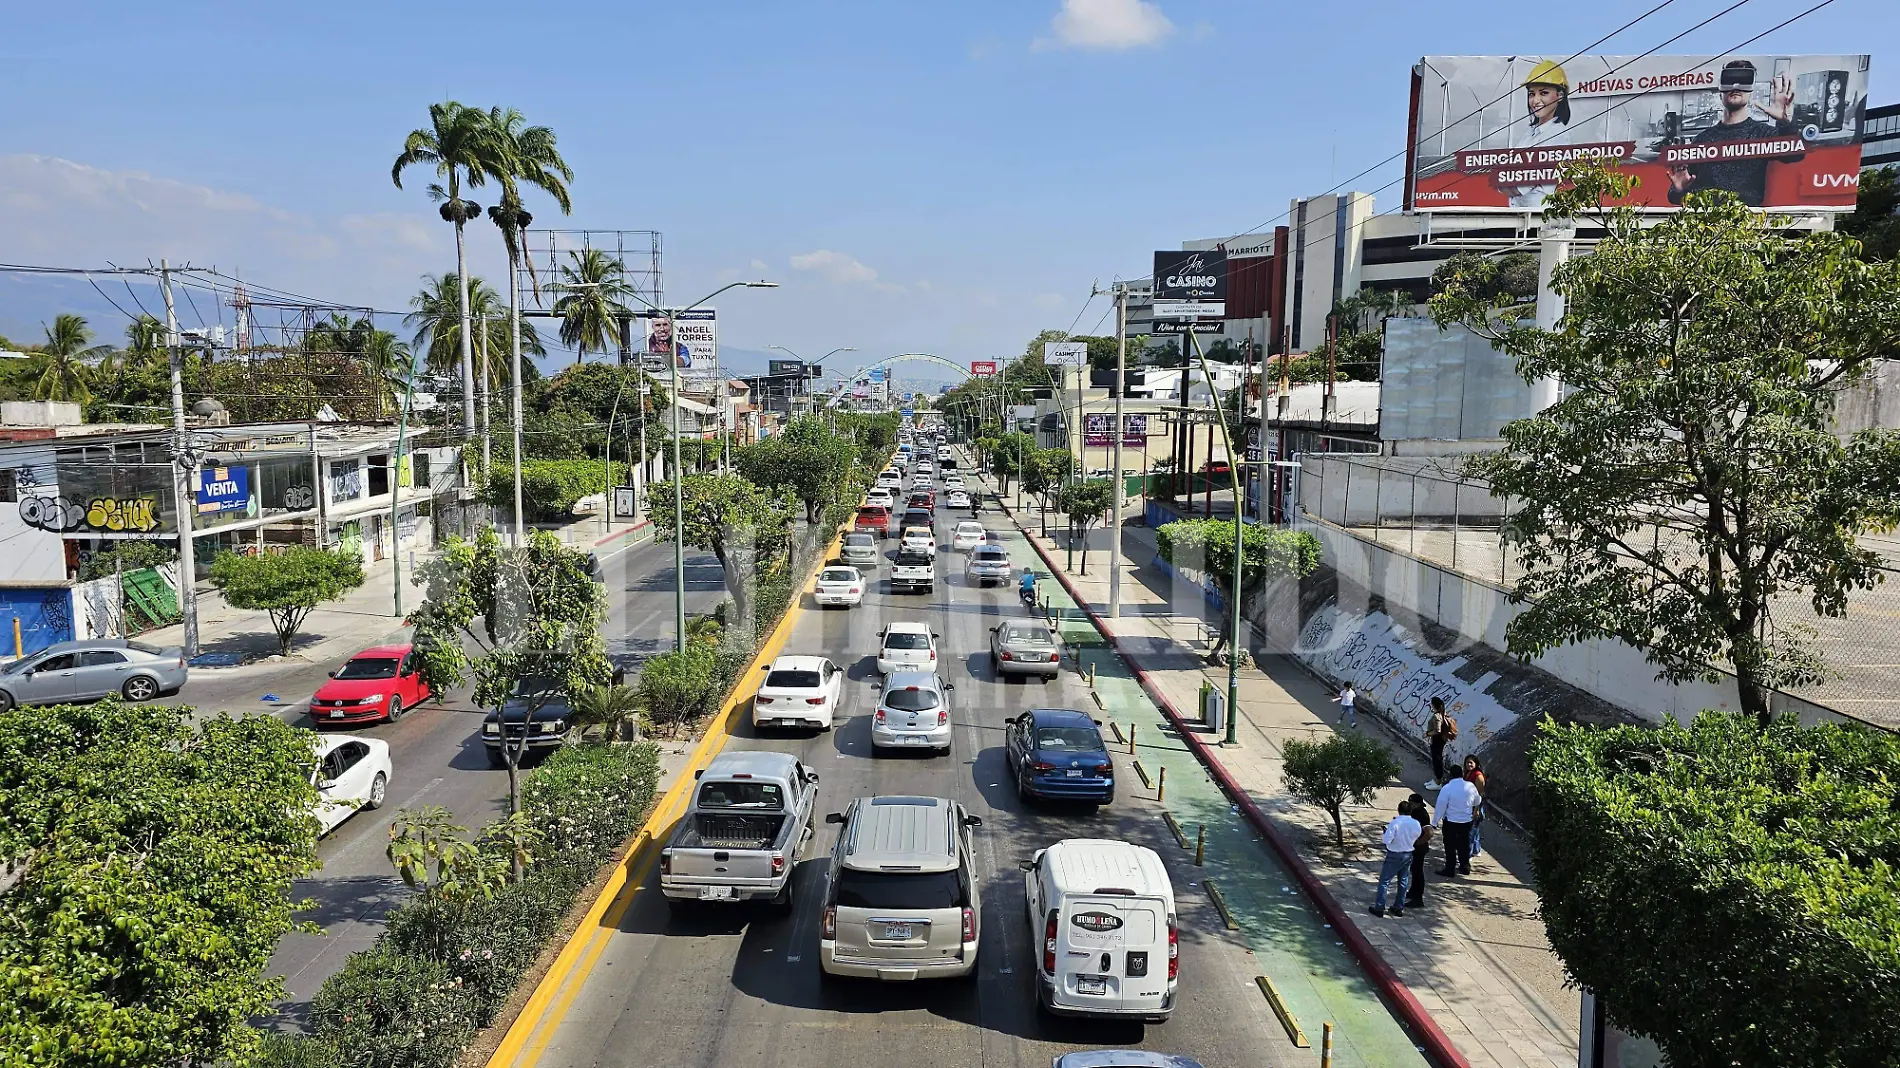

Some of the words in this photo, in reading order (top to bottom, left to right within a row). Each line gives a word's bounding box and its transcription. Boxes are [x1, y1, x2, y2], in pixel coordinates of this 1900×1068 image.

[1578, 77, 1633, 93] NUEVAS
[1638, 71, 1714, 89] CARRERAS
[1465, 149, 1523, 167] ENERGÍA
[1526, 151, 1535, 163] Y
[1538, 145, 1625, 162] DESARROLLO
[1667, 144, 1718, 161] DISEÑO
[1722, 139, 1805, 157] MULTIMEDIA
[1498, 167, 1586, 183] SUSTENTA
[1812, 173, 1860, 187] UVM
[1416, 190, 1459, 200] uvm.mx
[1228, 245, 1271, 256] MARRIOTT
[1166, 275, 1217, 288] CASINO
[676, 333, 713, 341] TORRES
[678, 326, 711, 334] ANGEL
[205, 480, 239, 497] VENTA
